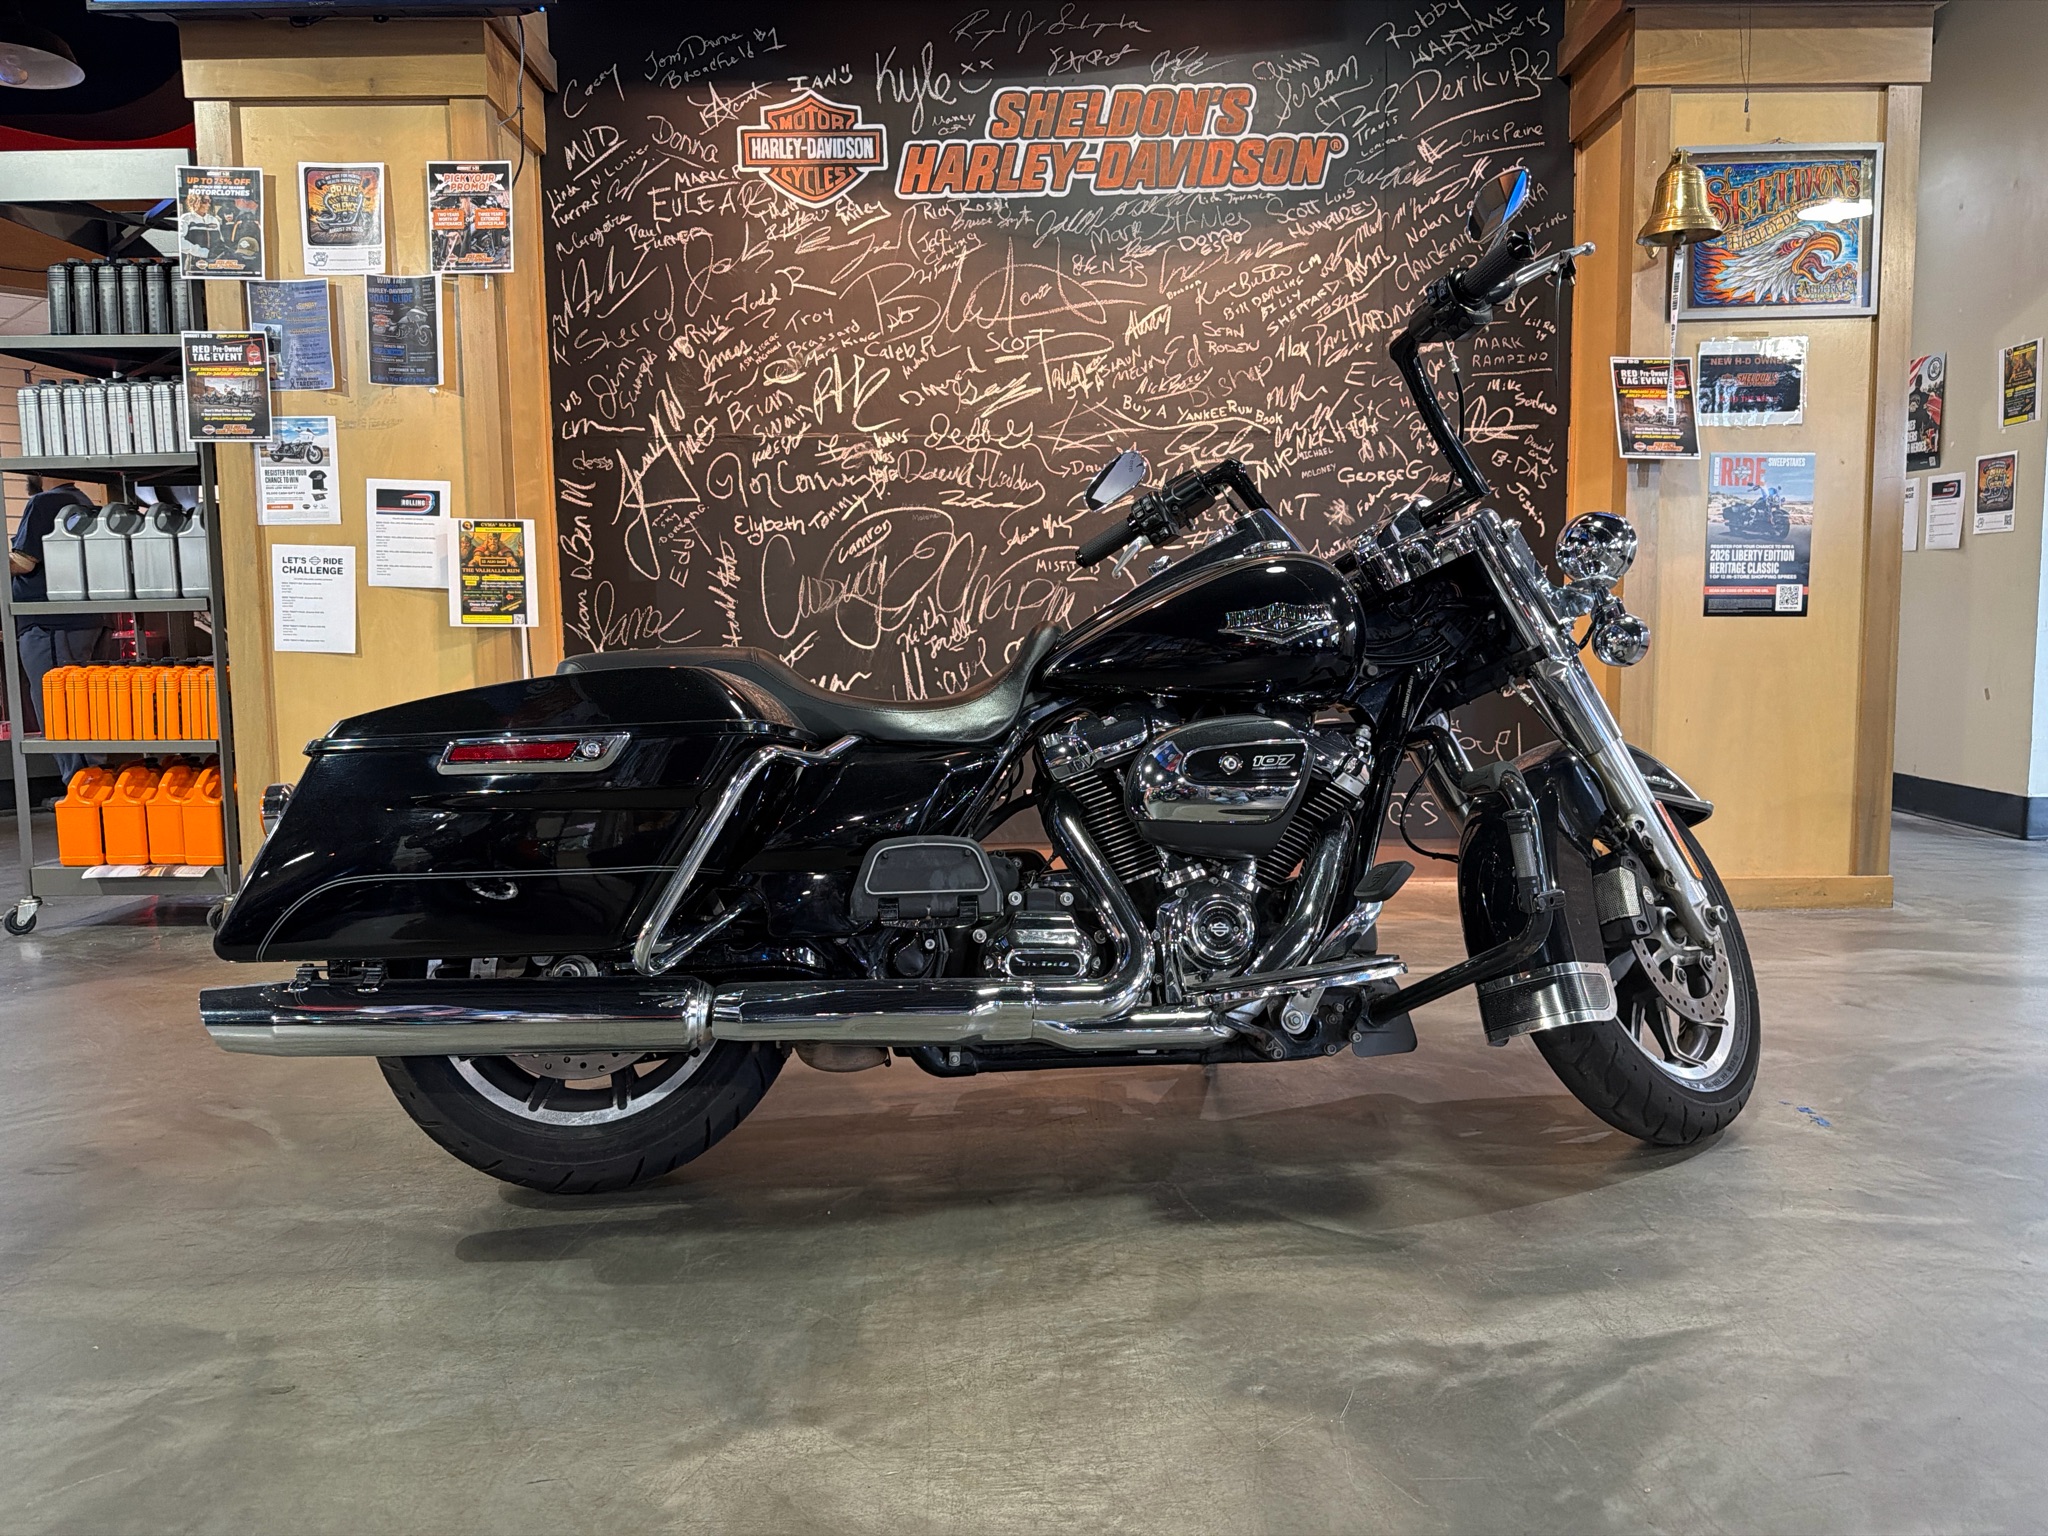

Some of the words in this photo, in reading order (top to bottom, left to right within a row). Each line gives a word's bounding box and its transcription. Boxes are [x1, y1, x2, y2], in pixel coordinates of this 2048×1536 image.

[875, 41, 958, 135] Kyle
[779, 105, 844, 131] MOTOR
[991, 87, 1252, 139] SHELDON'S
[646, 115, 720, 164] Donna
[1460, 128, 1501, 148] Chris
[750, 136, 875, 161] HARLEY-DAVIDSON
[201, 177, 213, 185] TO
[443, 173, 468, 183] PICK
[468, 173, 496, 183] YOUR
[779, 165, 847, 196] CYCLES
[188, 188, 251, 197] MOTORCLOTHES
[450, 182, 490, 192] PROMO!
[784, 307, 835, 334] Troy
[785, 319, 861, 358] Brassard
[1474, 337, 1525, 351] MARK
[192, 345, 210, 353] RED
[212, 344, 243, 353] Pre-Owned
[863, 340, 916, 362] Caleb
[192, 353, 211, 362] TAG
[213, 353, 243, 362] EVENT
[1471, 351, 1549, 369] RAMPINO
[1710, 357, 1733, 366] NEW
[1734, 357, 1752, 366] H-D
[1620, 369, 1638, 377] RED
[1639, 369, 1669, 377] Pre-Owned
[1621, 377, 1639, 385] TAG
[1640, 377, 1669, 385] EVENT
[1156, 405, 1168, 420] A
[1297, 447, 1335, 461] MICHAEL
[264, 469, 286, 477] REGISTER
[286, 469, 295, 477] FOR
[295, 469, 308, 477] YOUR
[1300, 462, 1337, 480] MOLONEY
[1337, 465, 1405, 485] GEORGE
[1720, 456, 1768, 487] RIDE
[1768, 456, 1806, 467] SWEEPSTAKES
[264, 476, 284, 484] CHANCE
[281, 555, 307, 565] LET'S
[322, 557, 344, 566] RIDE
[1709, 549, 1731, 562] 2026
[1731, 549, 1763, 562] LIBERTY
[1763, 549, 1795, 562] EDITION
[281, 565, 344, 576] CHALLENGE
[1709, 562, 1747, 574] HERITAGE
[1747, 562, 1780, 574] CLASSIC
[1252, 753, 1296, 767] 107
